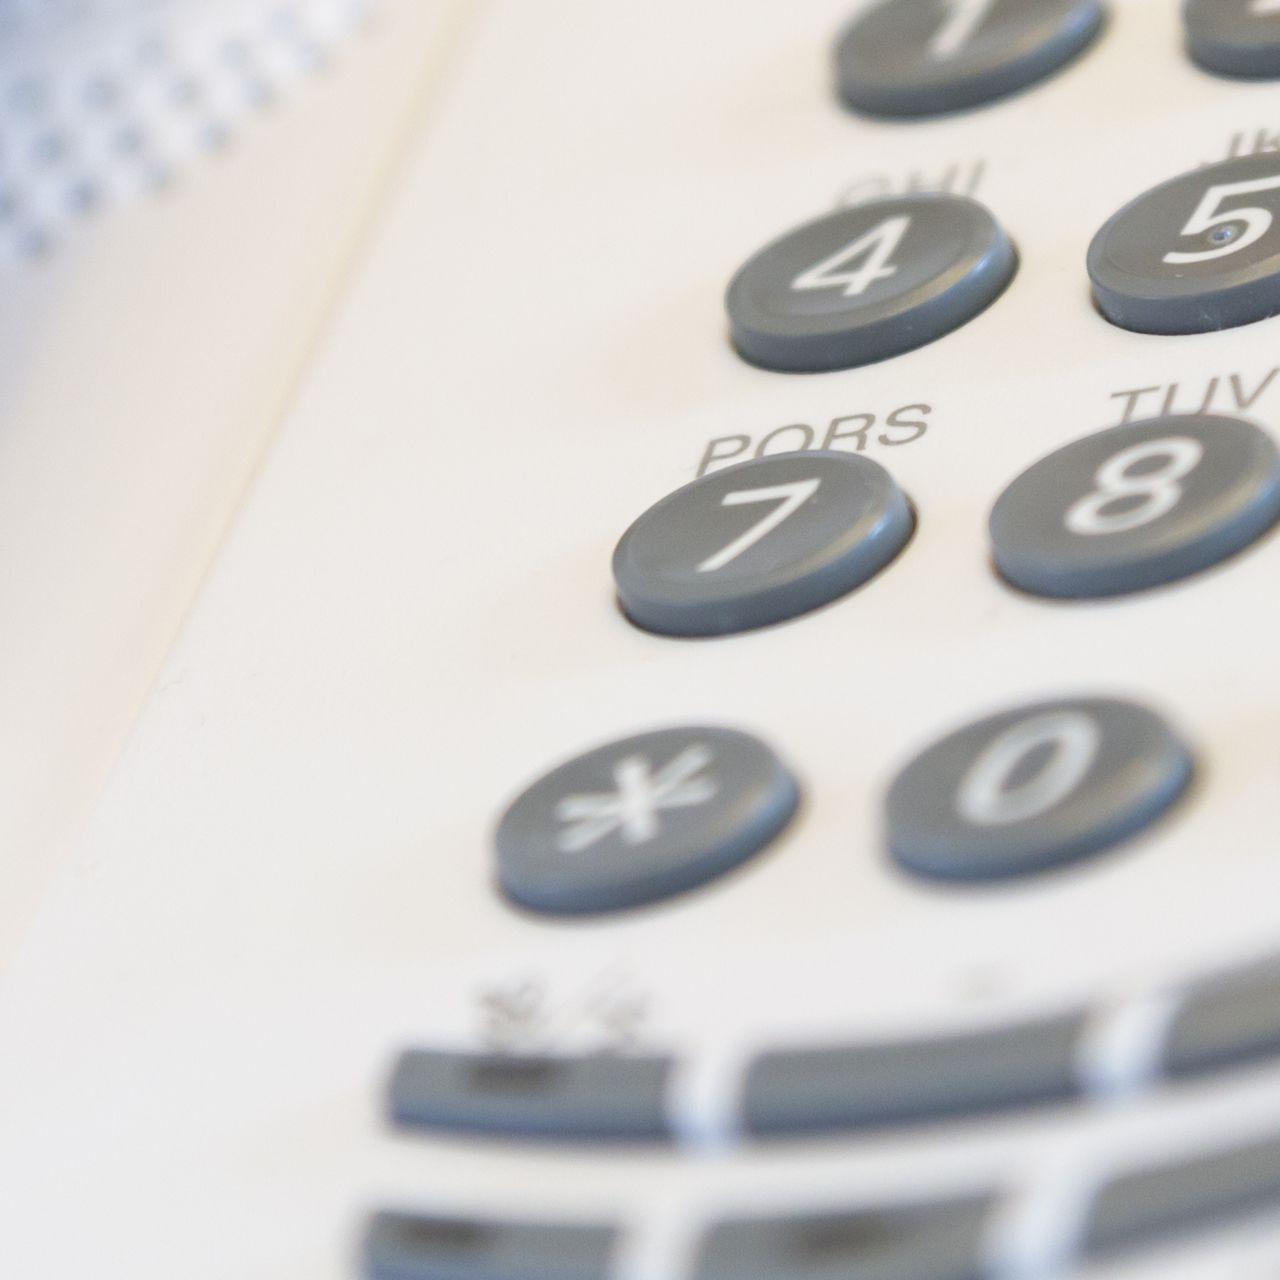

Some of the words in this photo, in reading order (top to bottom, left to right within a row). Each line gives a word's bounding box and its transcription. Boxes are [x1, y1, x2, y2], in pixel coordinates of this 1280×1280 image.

[788, 214, 913, 296] 4
[692, 476, 822, 573] 7
[1064, 435, 1204, 535] 8
[951, 710, 1102, 825] 0
